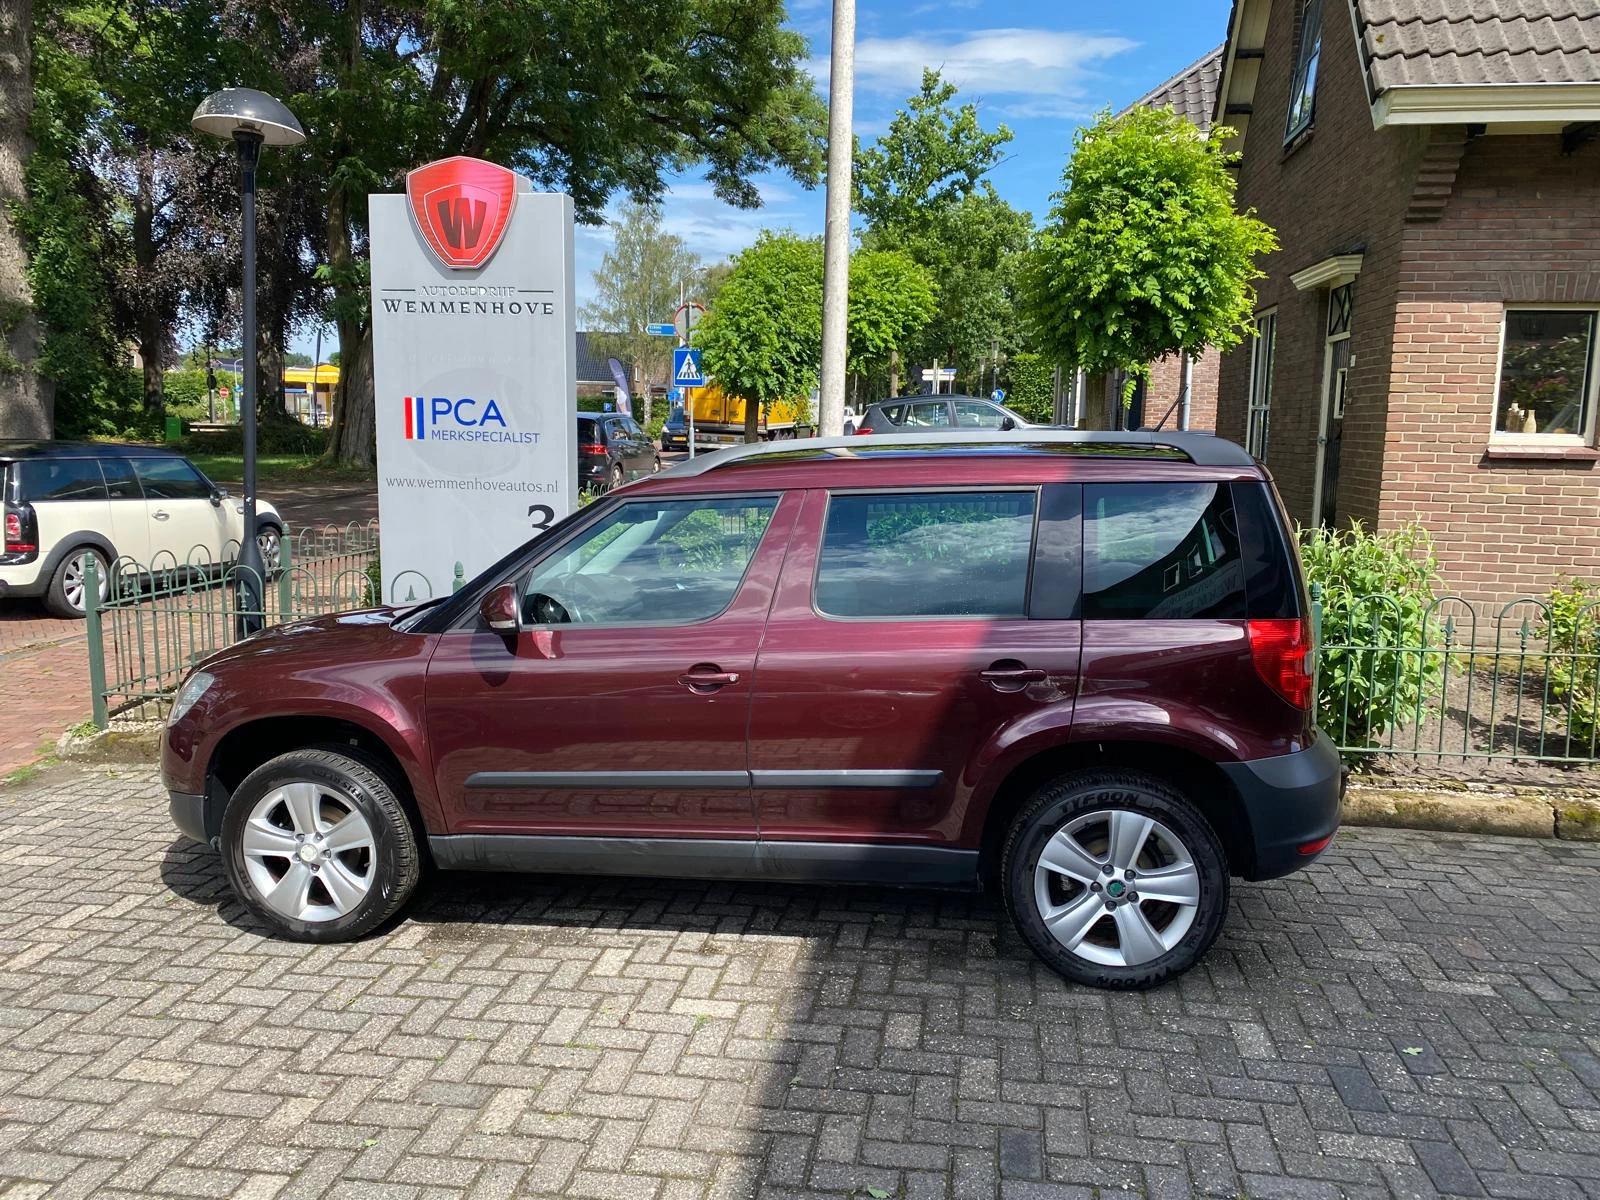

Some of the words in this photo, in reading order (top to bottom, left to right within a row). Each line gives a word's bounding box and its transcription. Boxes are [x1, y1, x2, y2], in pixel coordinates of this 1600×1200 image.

[437, 197, 487, 250] W
[419, 285, 516, 297] AUTOBEDRIJF
[381, 298, 554, 315] WEMMENHOVE
[431, 397, 507, 428] PCA
[431, 429, 541, 444] MERKSPECIALIST
[386, 477, 558, 493] www.wemmenhoveautos.nl
[1061, 790, 1139, 814] TYFOON
